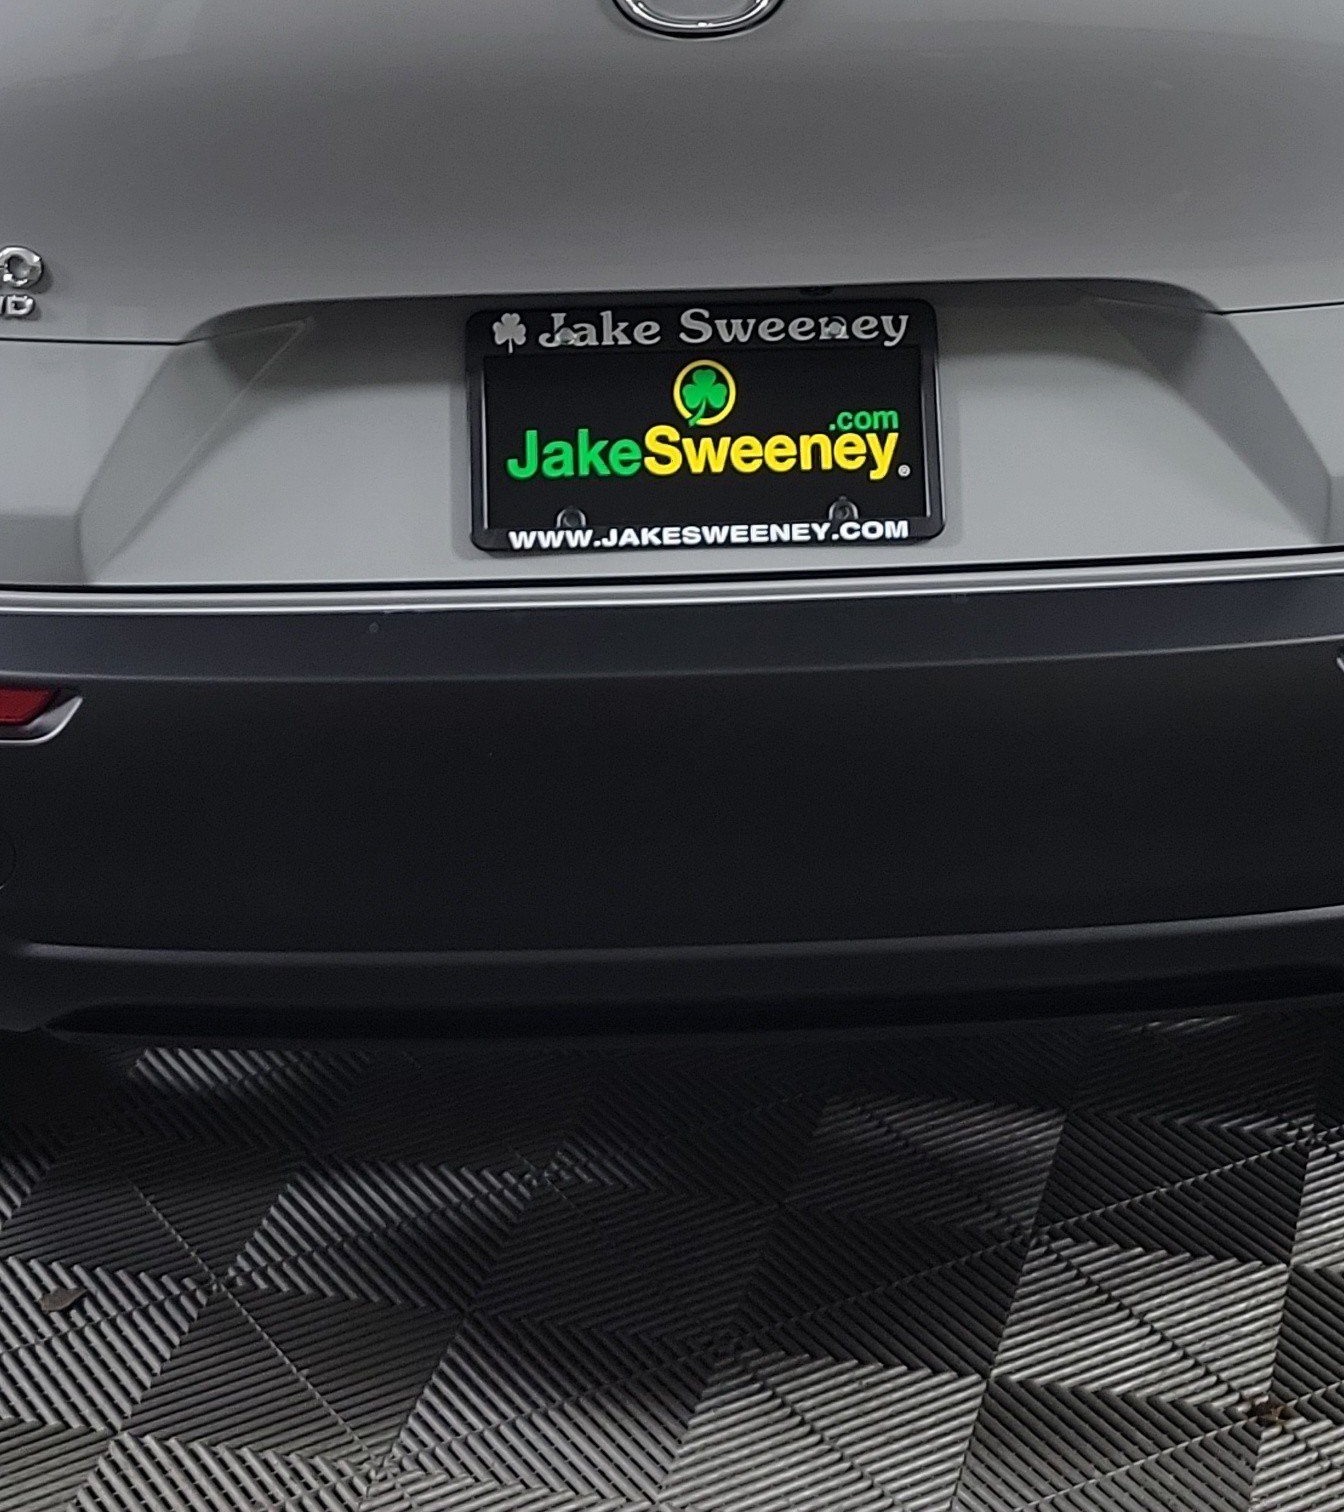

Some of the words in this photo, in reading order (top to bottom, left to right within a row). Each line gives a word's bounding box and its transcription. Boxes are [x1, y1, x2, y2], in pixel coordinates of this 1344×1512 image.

[539, 310, 661, 348] Jake
[679, 308, 910, 347] Sweeney
[828, 409, 901, 432] .com
[508, 520, 909, 550] WWW.JAKESWEENEY.COM
